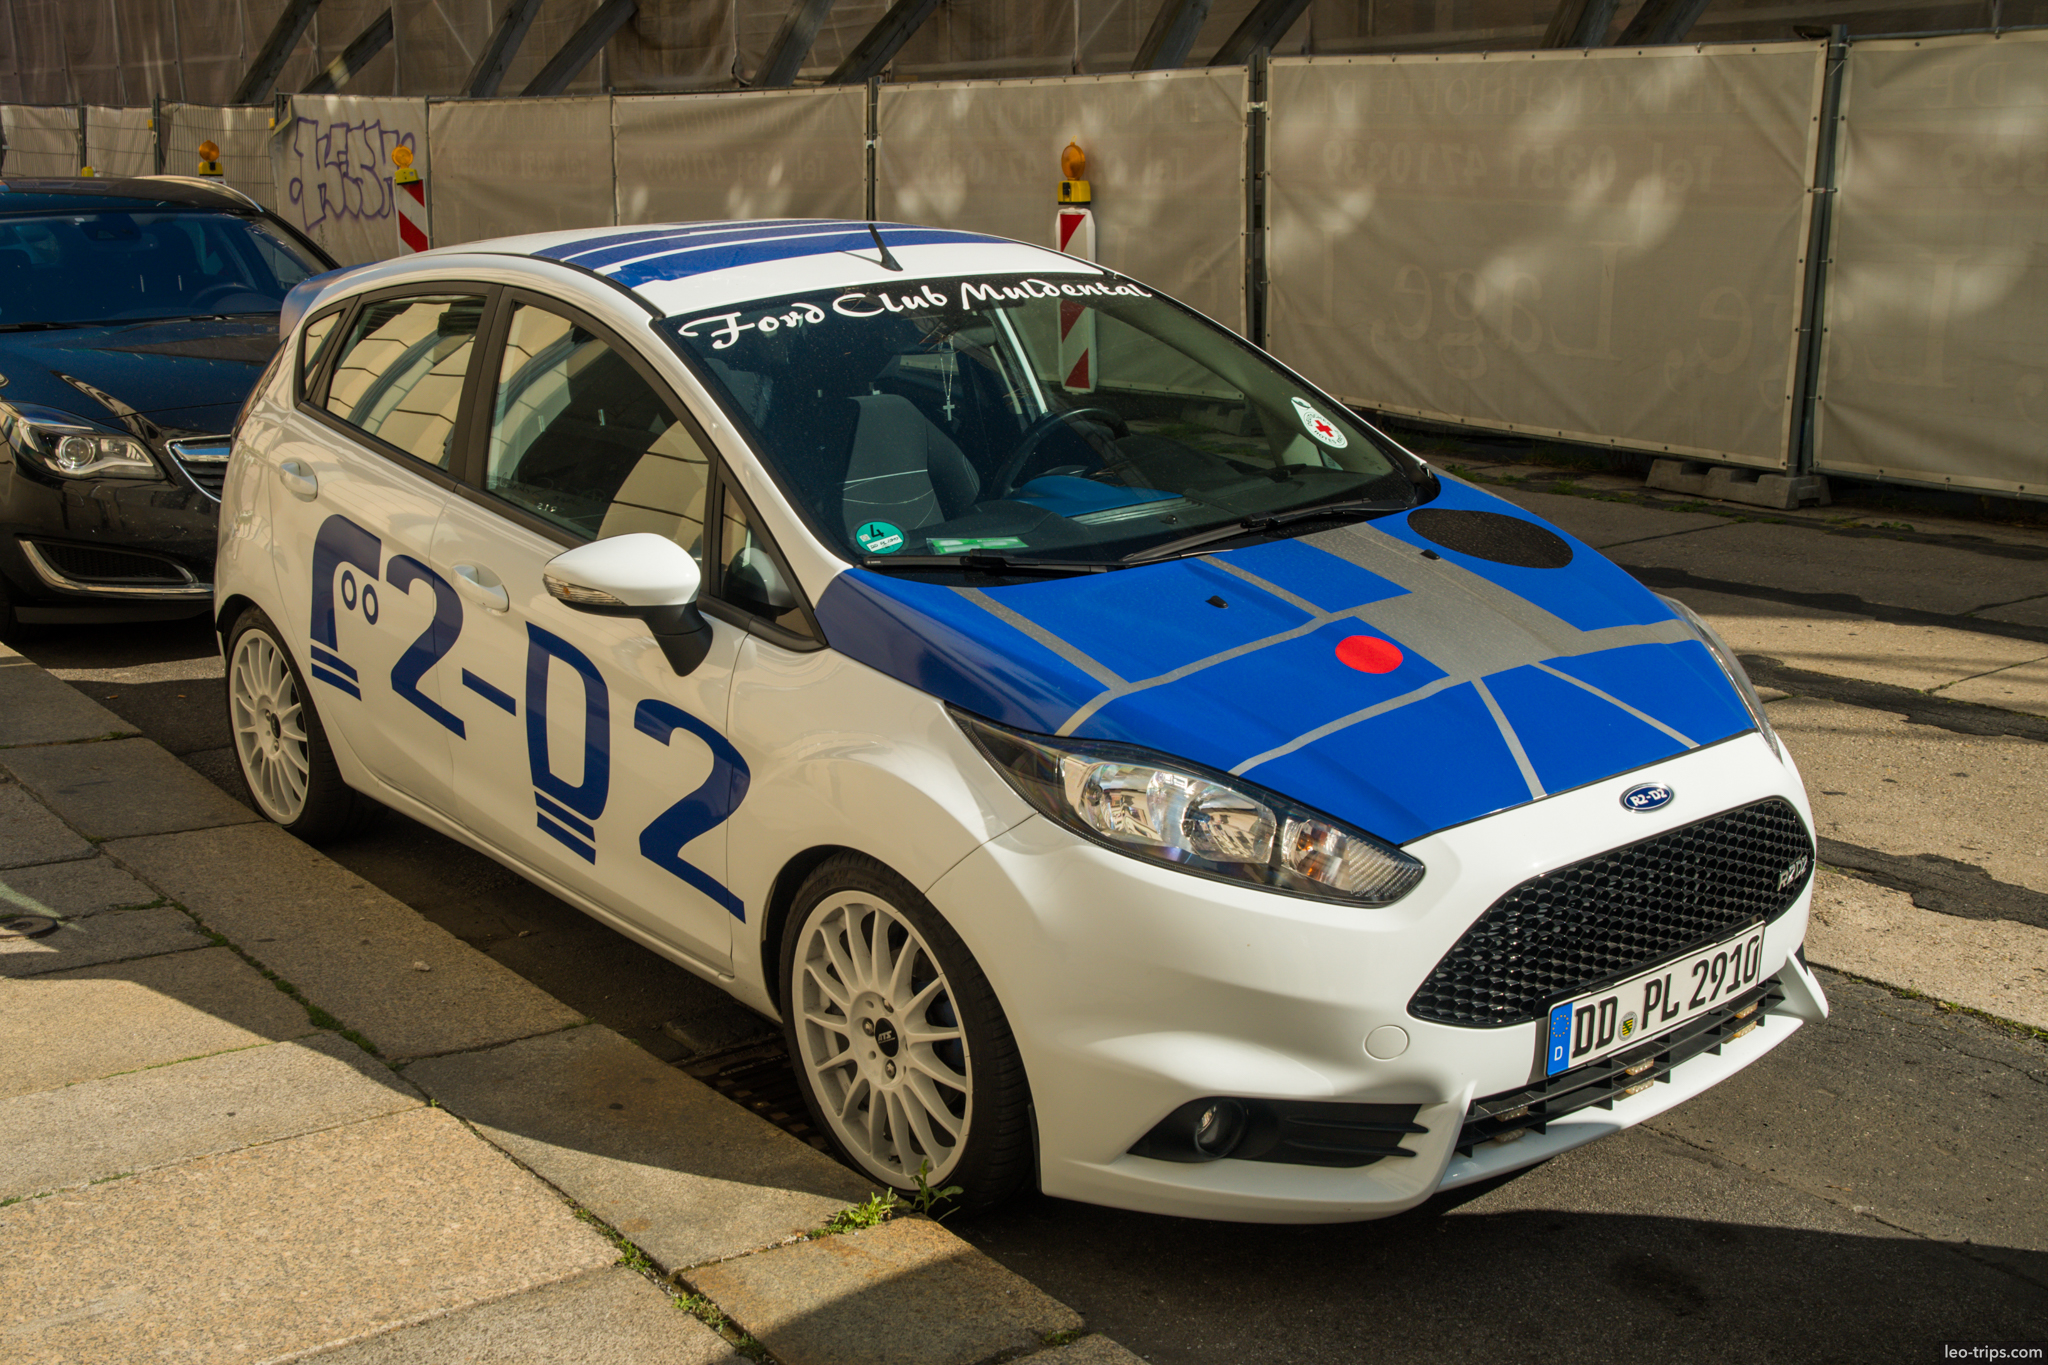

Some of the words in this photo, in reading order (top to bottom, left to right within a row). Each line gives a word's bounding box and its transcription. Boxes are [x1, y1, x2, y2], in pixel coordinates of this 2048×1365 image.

[677, 301, 825, 350] Ford
[832, 284, 948, 318] Club
[961, 278, 1153, 311] Muldental
[870, 524, 884, 537] 4
[1629, 788, 1668, 807] R2-D2
[1777, 855, 1808, 891] R2D2
[1572, 995, 1618, 1059] DD
[1641, 971, 1680, 1031] PL
[1688, 934, 1760, 1010] 2910
[1553, 1045, 1563, 1061] D
